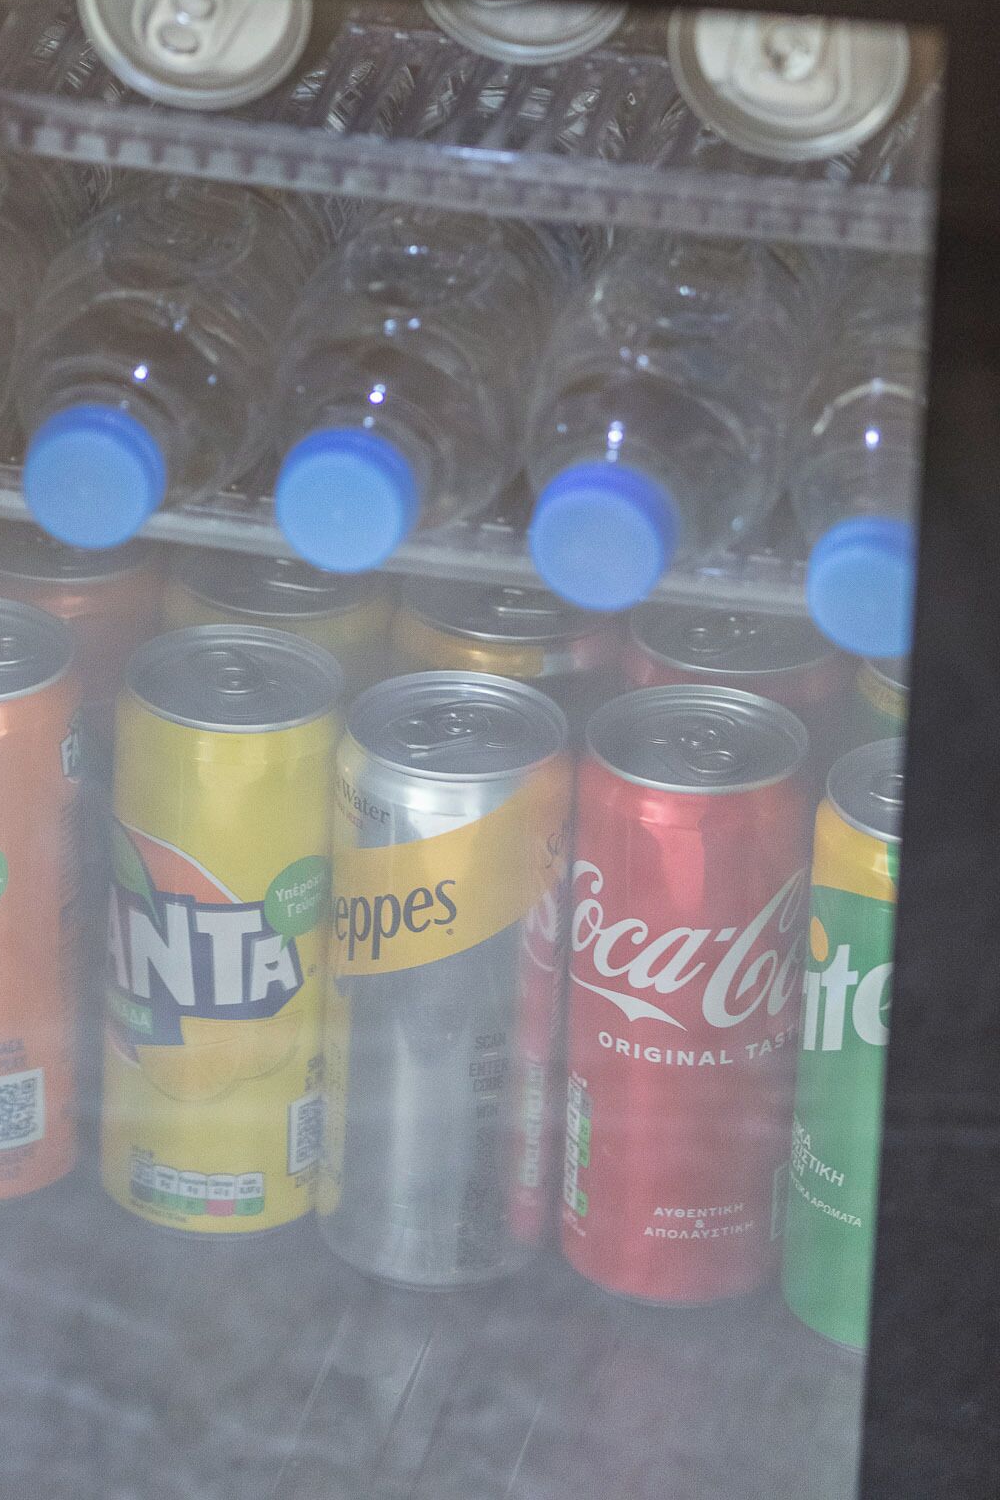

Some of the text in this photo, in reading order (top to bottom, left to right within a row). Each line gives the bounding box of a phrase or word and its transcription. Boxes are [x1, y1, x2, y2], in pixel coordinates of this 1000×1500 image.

[802, 940, 895, 1053] ite
[597, 1030, 735, 1067] ORIGINAL
[653, 1202, 746, 1219] ΑΥΘΕΝΤΙΚΗ
